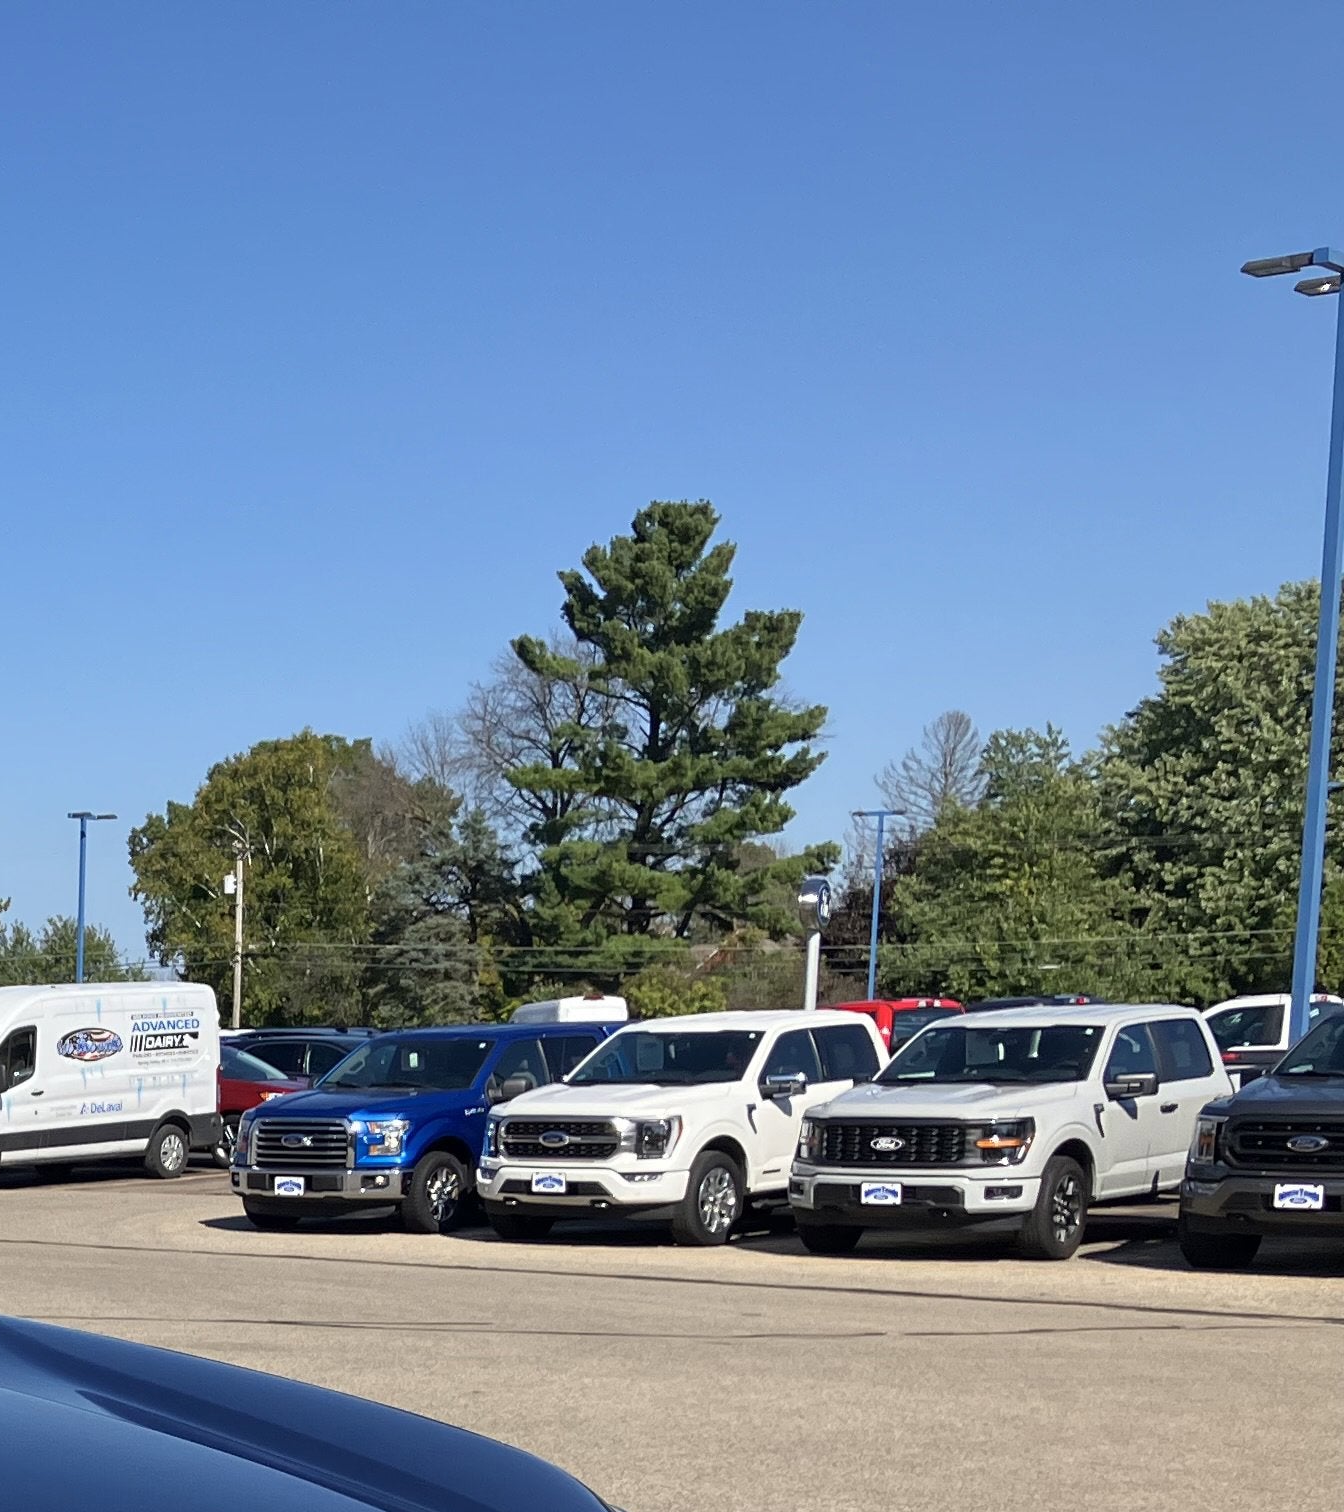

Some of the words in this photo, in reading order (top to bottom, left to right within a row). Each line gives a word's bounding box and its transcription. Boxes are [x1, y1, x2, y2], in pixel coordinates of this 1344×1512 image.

[132, 1018, 200, 1032] ADVANCED
[145, 1034, 182, 1049] DAIRY
[90, 1101, 123, 1114] DeLaval
